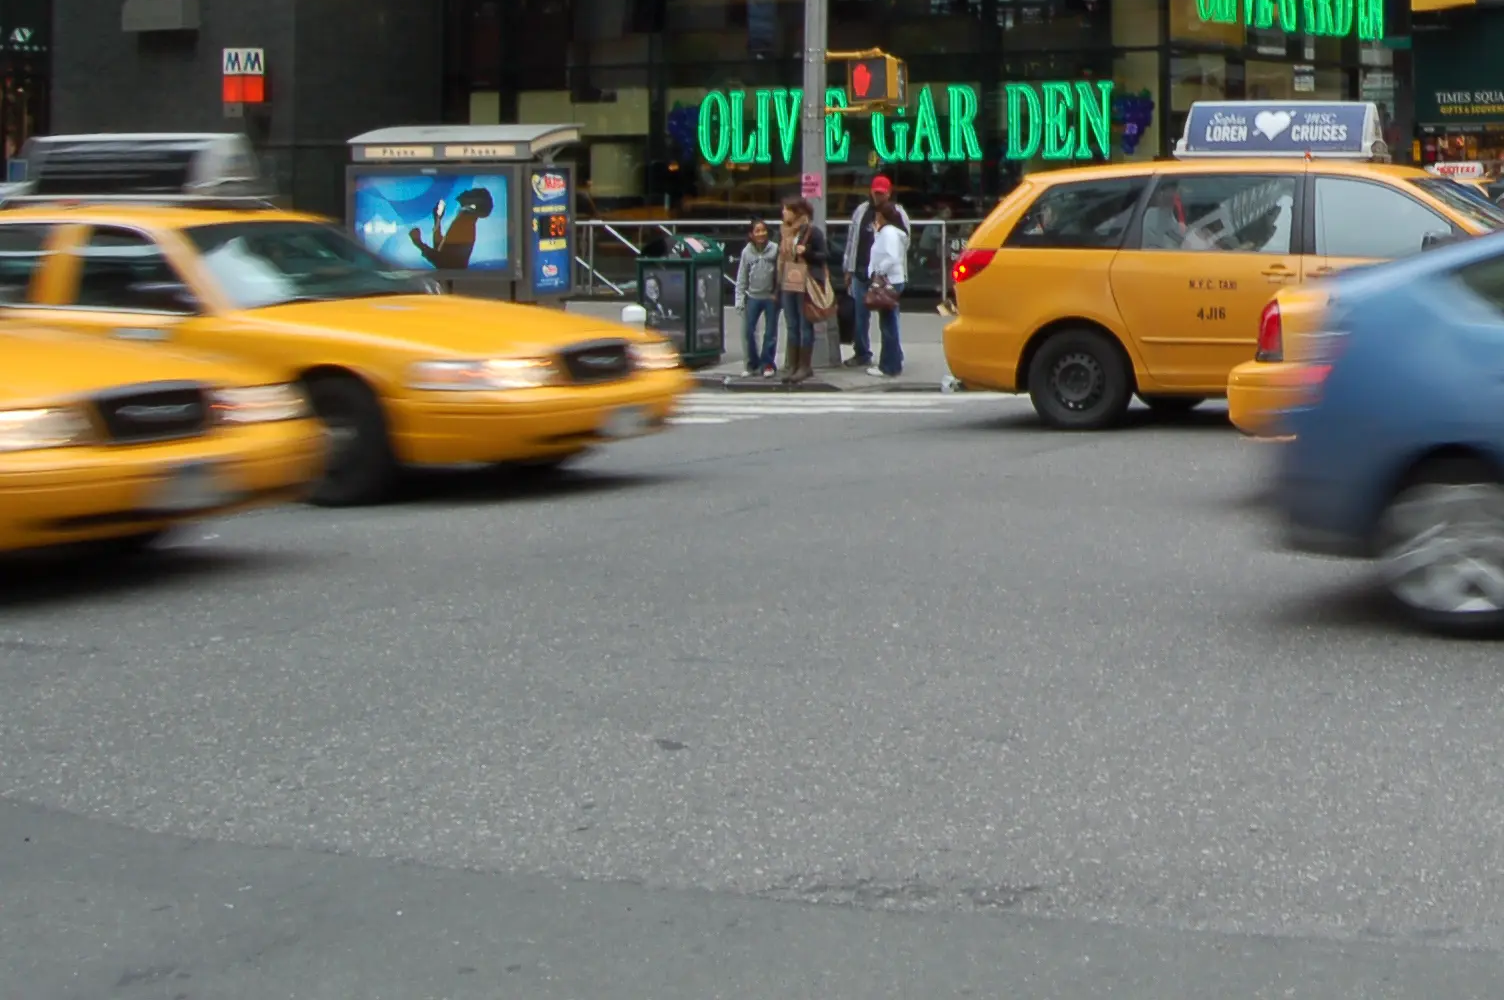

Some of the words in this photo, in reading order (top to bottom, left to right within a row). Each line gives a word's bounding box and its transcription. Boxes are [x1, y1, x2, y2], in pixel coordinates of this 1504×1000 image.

[1435, 91, 1472, 104] TIMES
[1206, 125, 1248, 142] LOREN
[1290, 124, 1348, 142] CRUISES
[382, 146, 416, 157] Phone
[462, 145, 497, 156] Phone
